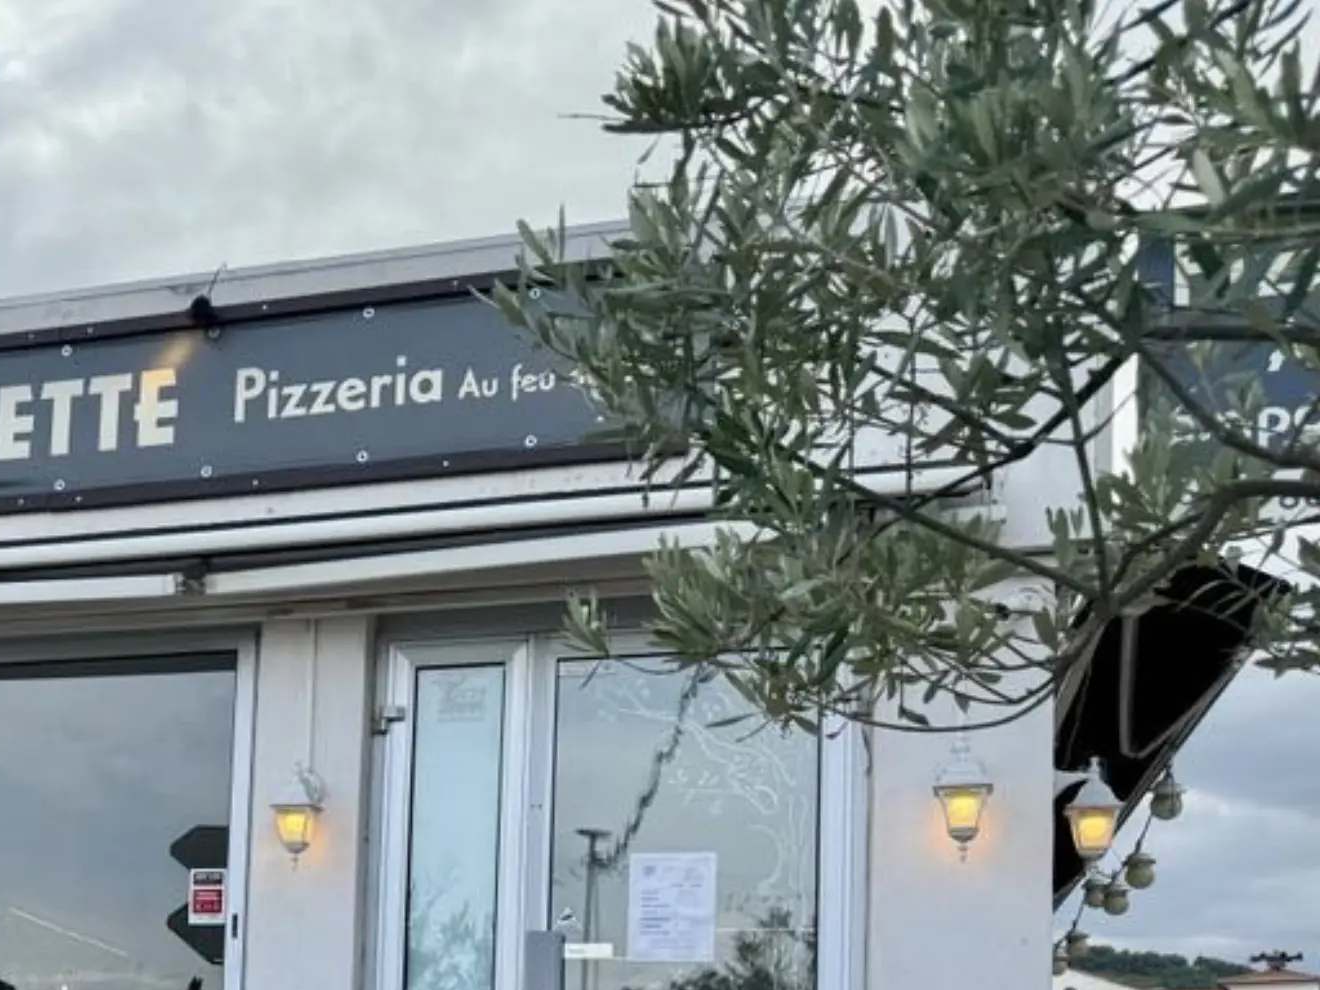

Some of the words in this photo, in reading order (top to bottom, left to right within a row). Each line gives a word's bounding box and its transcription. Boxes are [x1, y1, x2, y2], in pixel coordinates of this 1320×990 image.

[234, 357, 444, 423] Pizzeria
[458, 366, 499, 400] Au
[511, 363, 557, 400] feu
